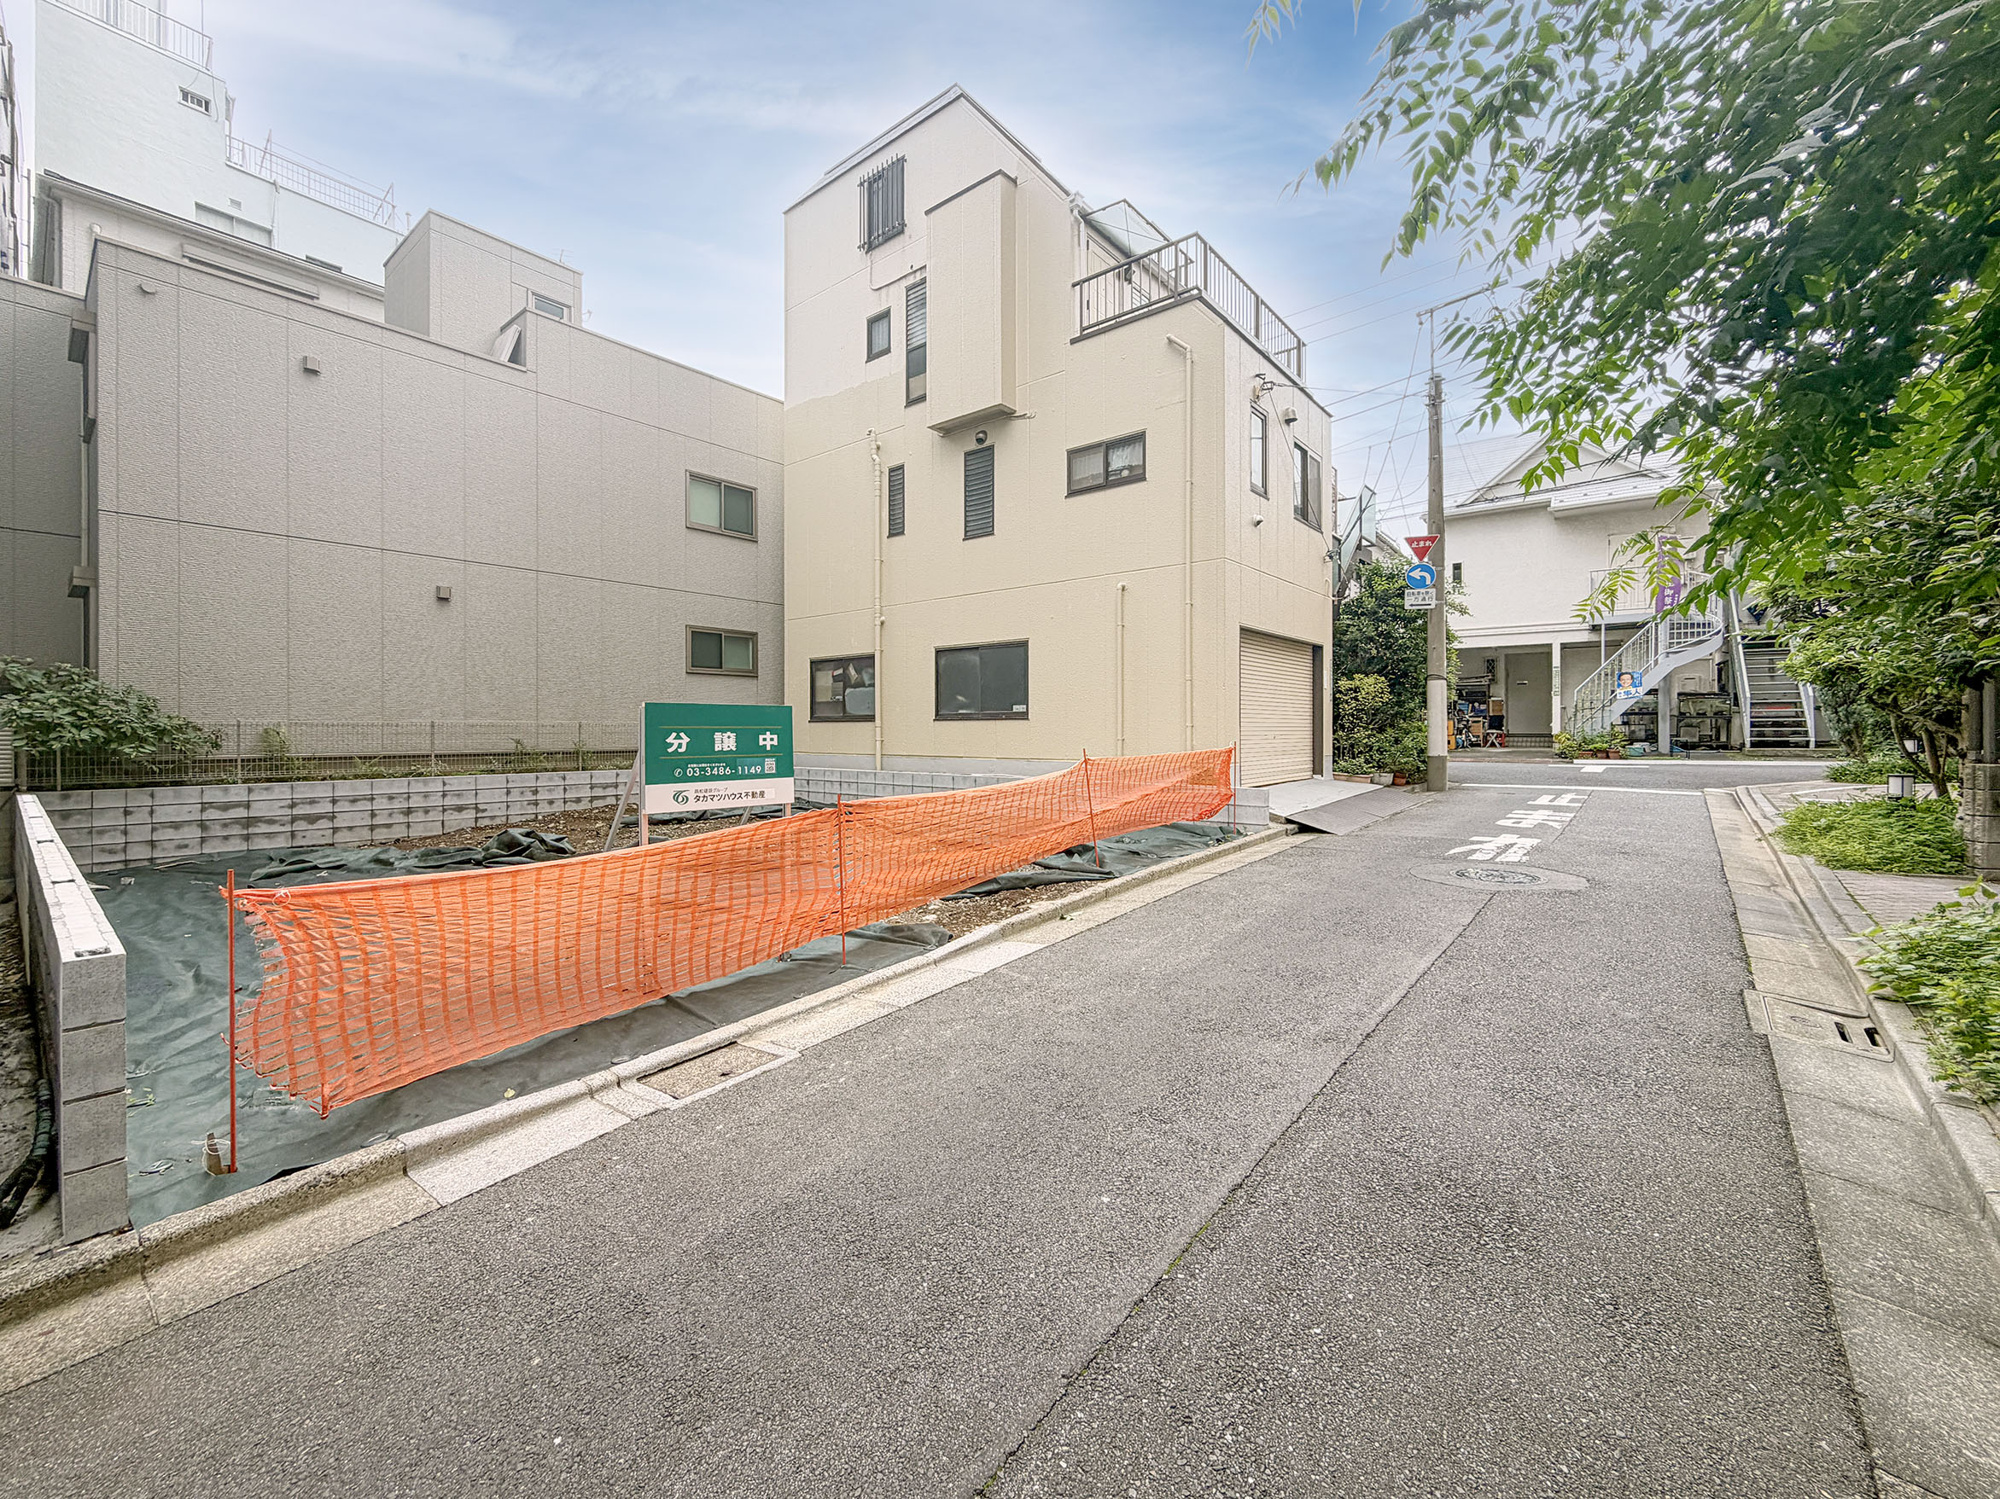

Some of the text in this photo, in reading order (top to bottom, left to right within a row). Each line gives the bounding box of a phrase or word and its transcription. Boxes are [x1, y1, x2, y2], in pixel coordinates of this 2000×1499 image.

[1411, 540, 1432, 548] 止まれ
[665, 731, 778, 753] 分譲中
[686, 765, 762, 777] 03-3486-1149
[693, 790, 766, 803] タカマツハウス不動産
[1445, 792, 1589, 862] 止まれ
